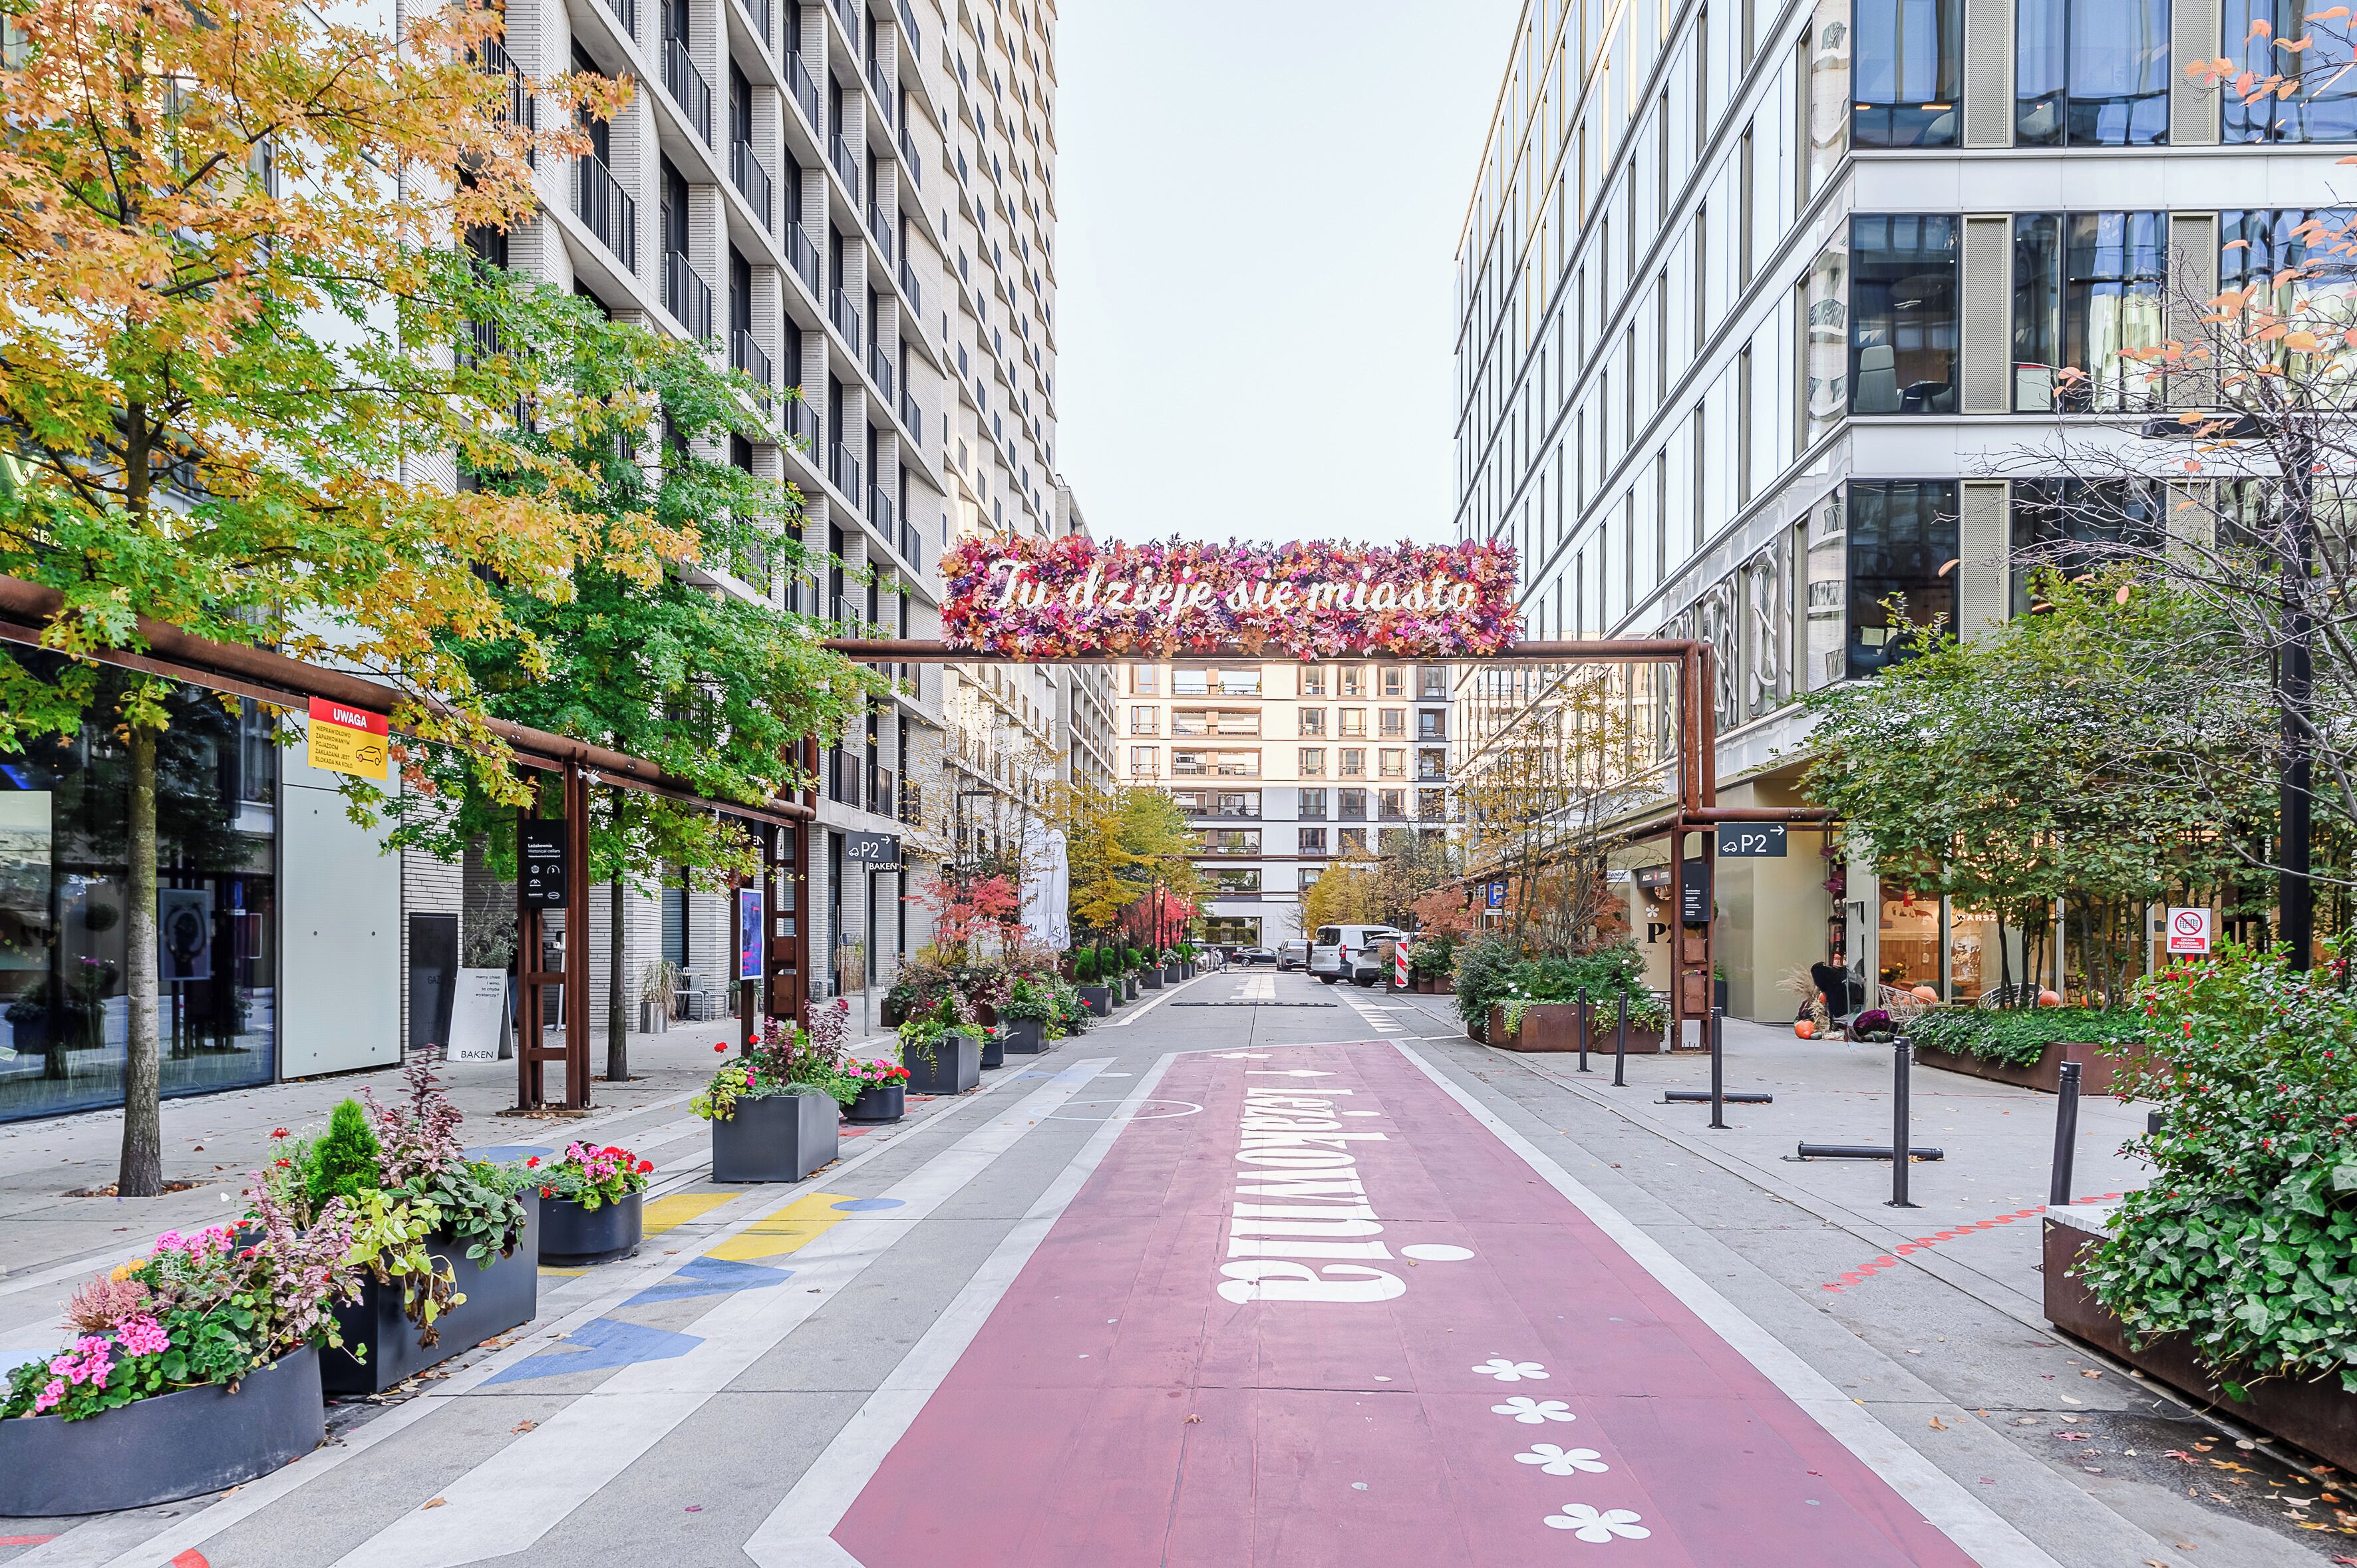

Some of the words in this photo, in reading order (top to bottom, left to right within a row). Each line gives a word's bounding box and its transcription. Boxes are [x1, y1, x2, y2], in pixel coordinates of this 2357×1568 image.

[989, 559, 1054, 610] Tu
[1306, 565, 1477, 613] miasto
[333, 707, 367, 728] UWAGA
[316, 725, 351, 738] NIEPRAWIDŁOWO
[315, 732, 351, 745] ZAPARKOWANYM
[315, 740, 339, 750] POJAZDOM
[315, 748, 340, 758] ZAKŁADANA
[315, 756, 334, 764] BLOKADA
[860, 840, 879, 858] P2
[1741, 834, 1766, 853] P2
[1493, 885, 1503, 899] P
[427, 975, 442, 985] GAZ
[460, 1050, 494, 1058] BAKEN
